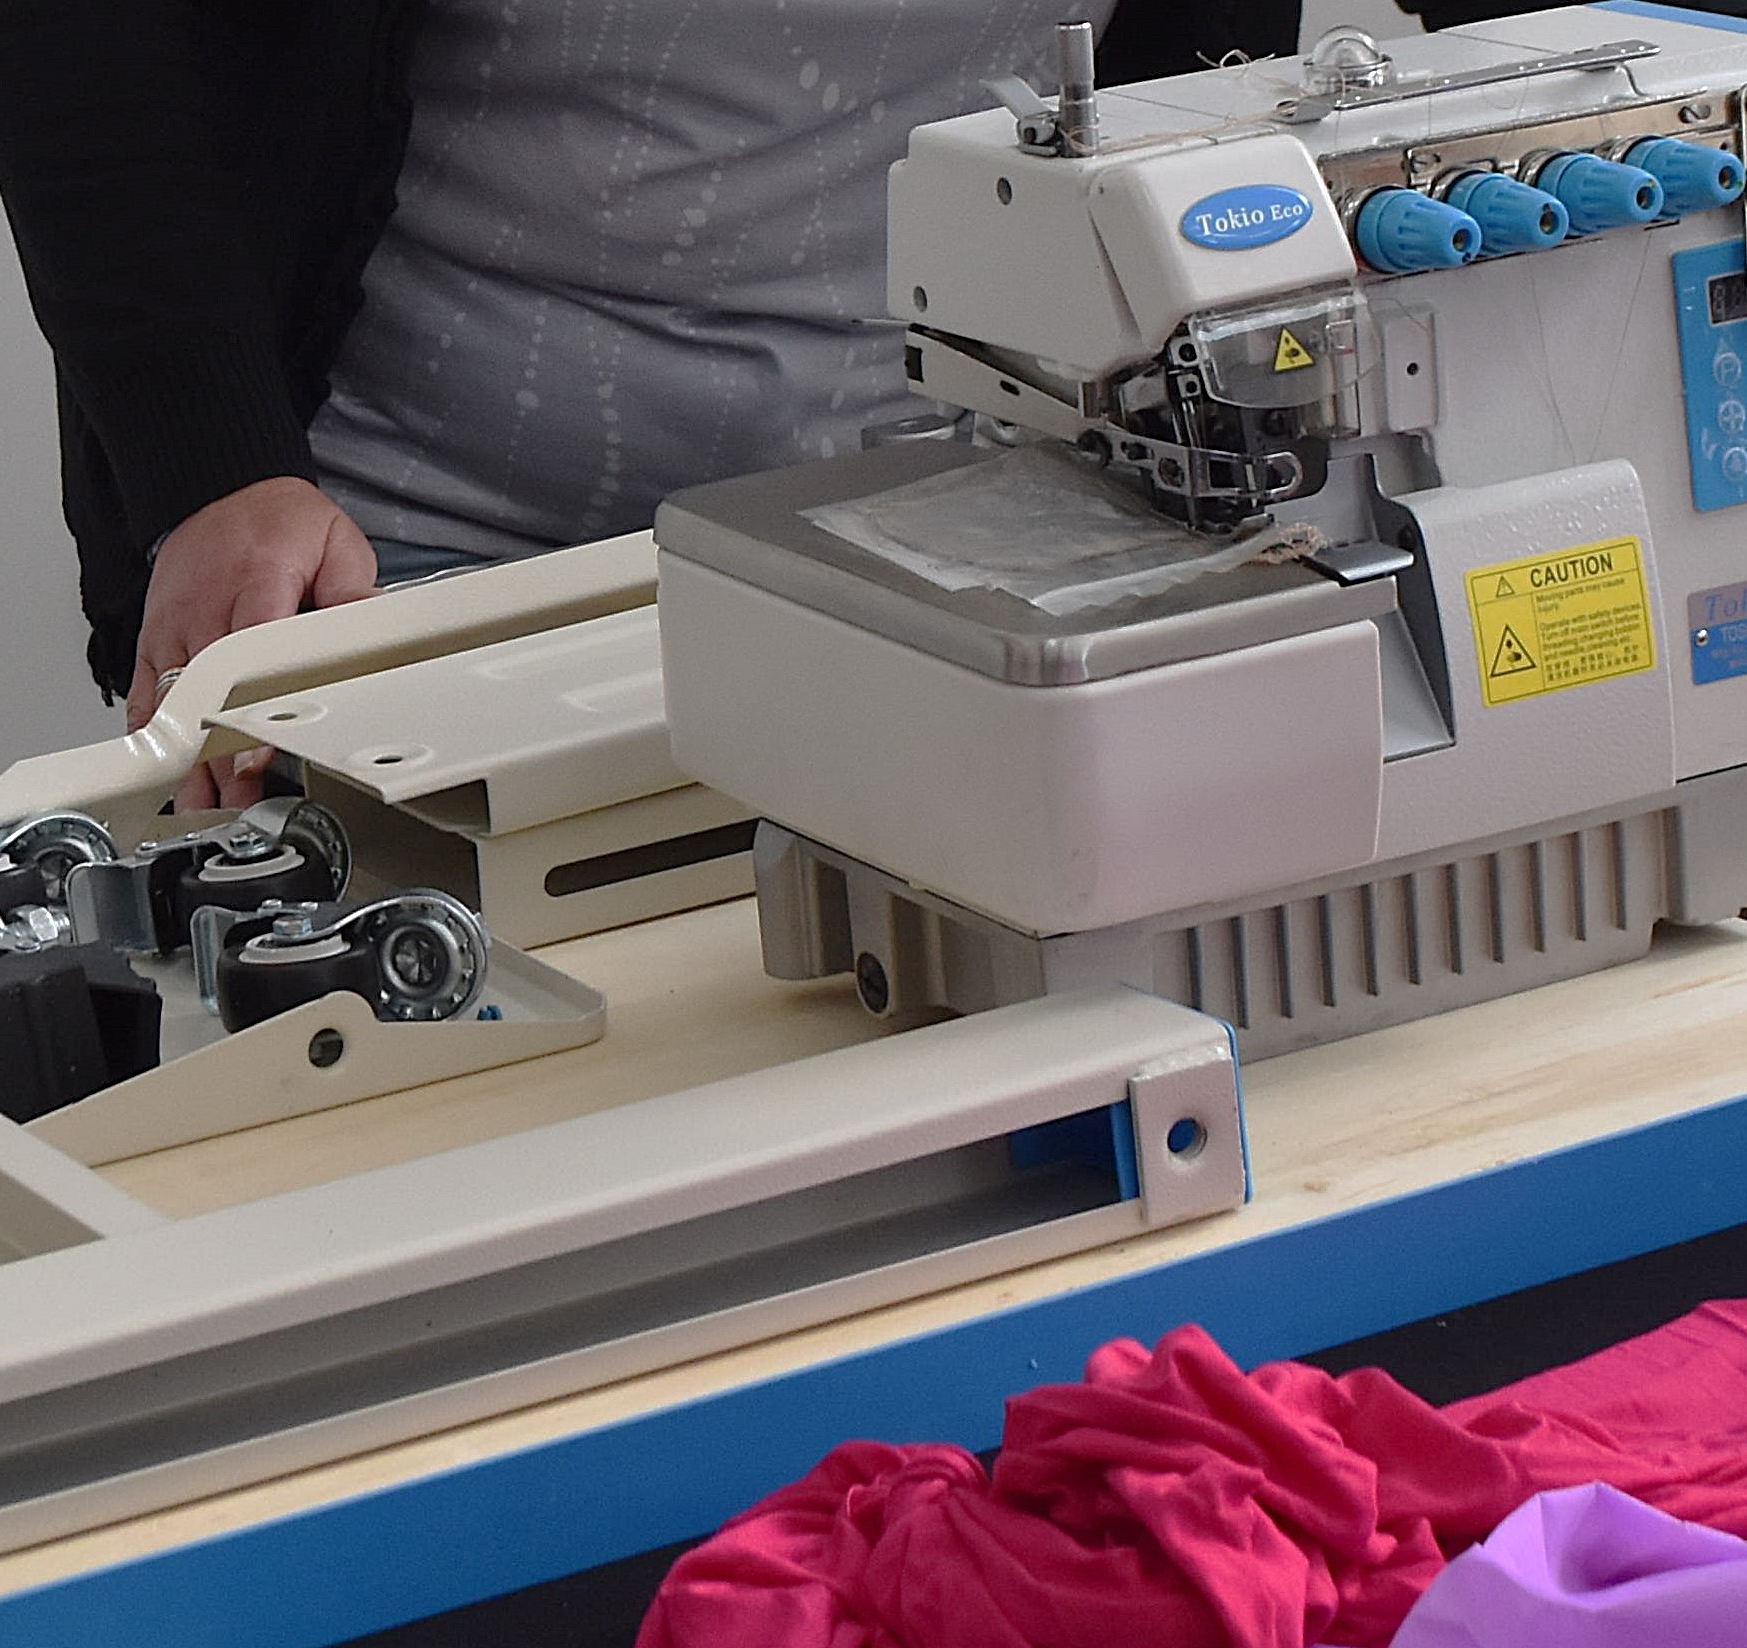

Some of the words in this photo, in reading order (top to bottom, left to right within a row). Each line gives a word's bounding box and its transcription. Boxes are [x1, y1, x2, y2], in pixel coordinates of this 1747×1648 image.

[1196, 207, 1264, 236] Tokio
[1269, 203, 1303, 221] Eco
[1530, 552, 1614, 588] CAUTION
